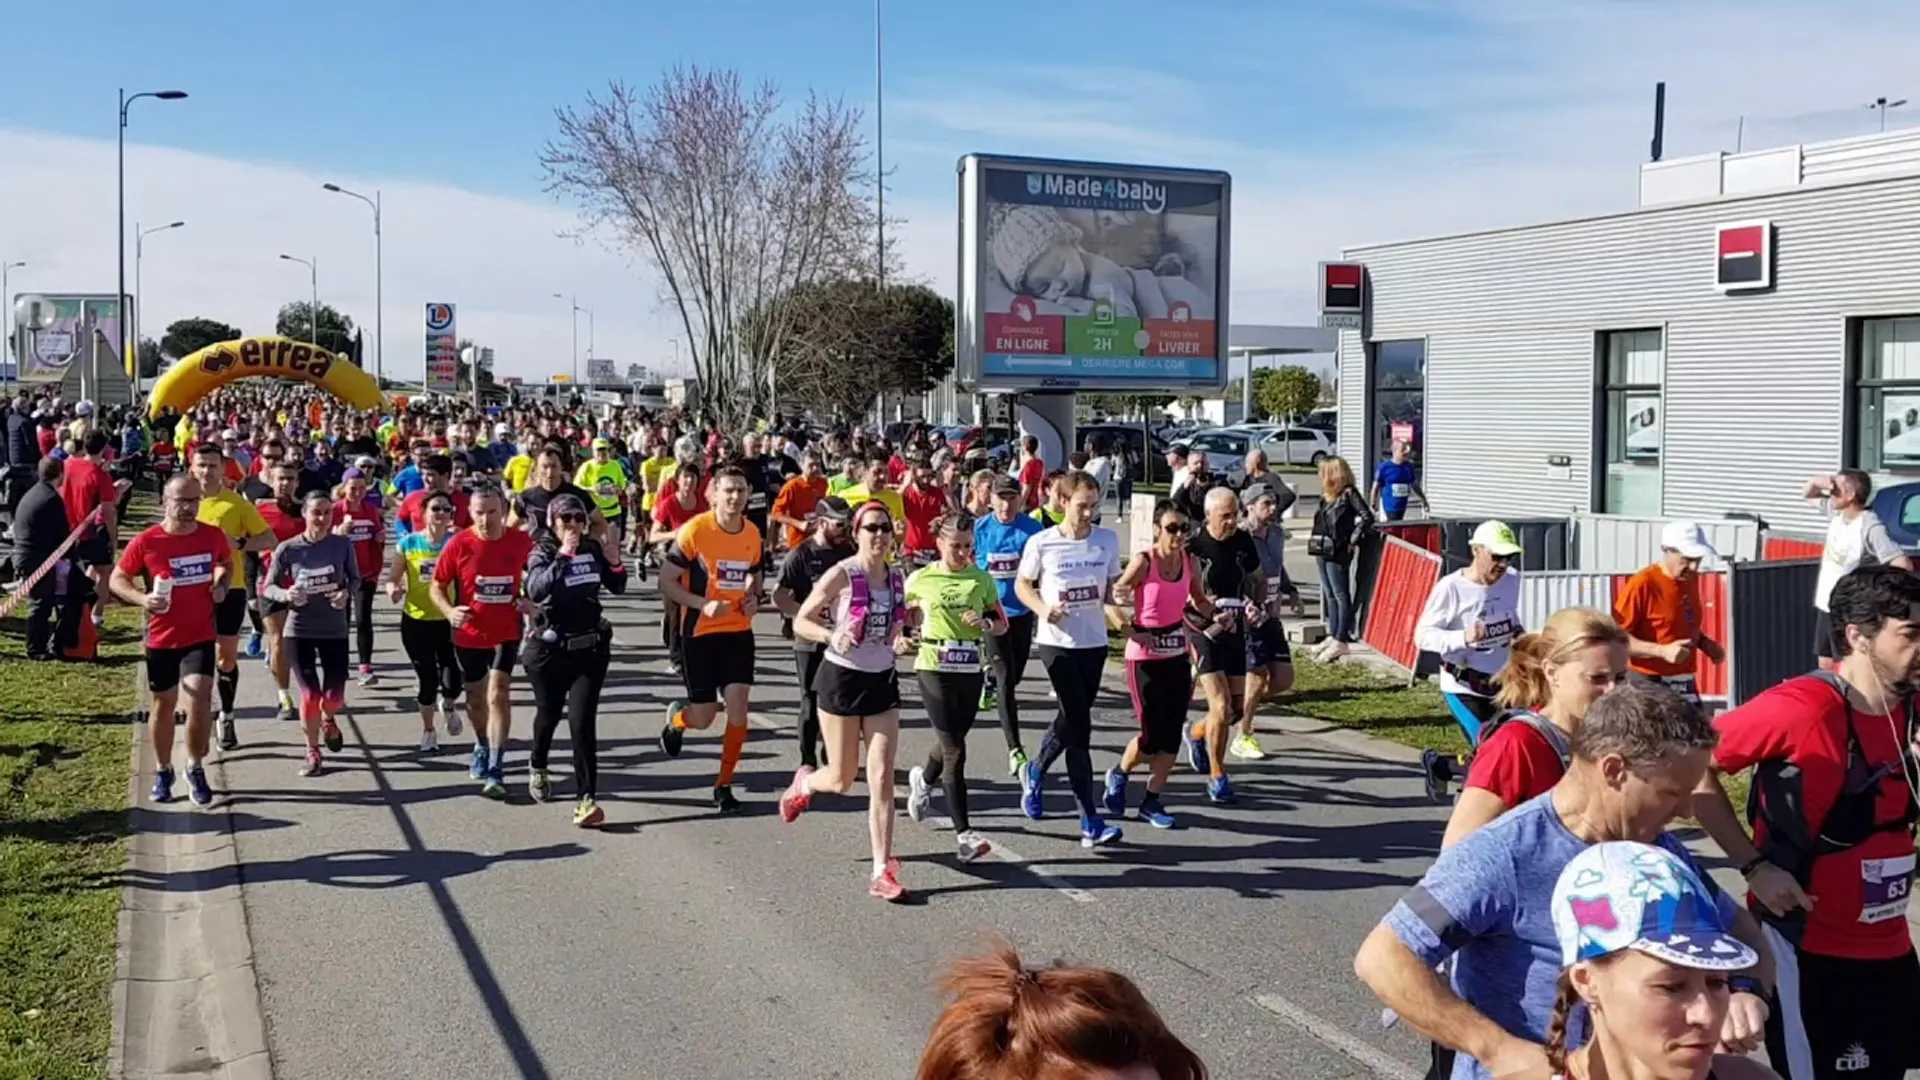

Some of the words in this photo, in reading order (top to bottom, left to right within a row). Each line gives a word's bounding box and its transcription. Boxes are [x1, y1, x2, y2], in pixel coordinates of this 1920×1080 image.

[1045, 174, 1167, 214] Made4baby
[996, 338, 1012, 349] EN
[1015, 338, 1050, 350] LIGNE
[1093, 338, 1112, 351] 2H
[1159, 341, 1200, 353] LIVRER
[180, 565, 203, 576] 394
[1067, 590, 1091, 601] 925
[1887, 877, 1908, 899] 63
